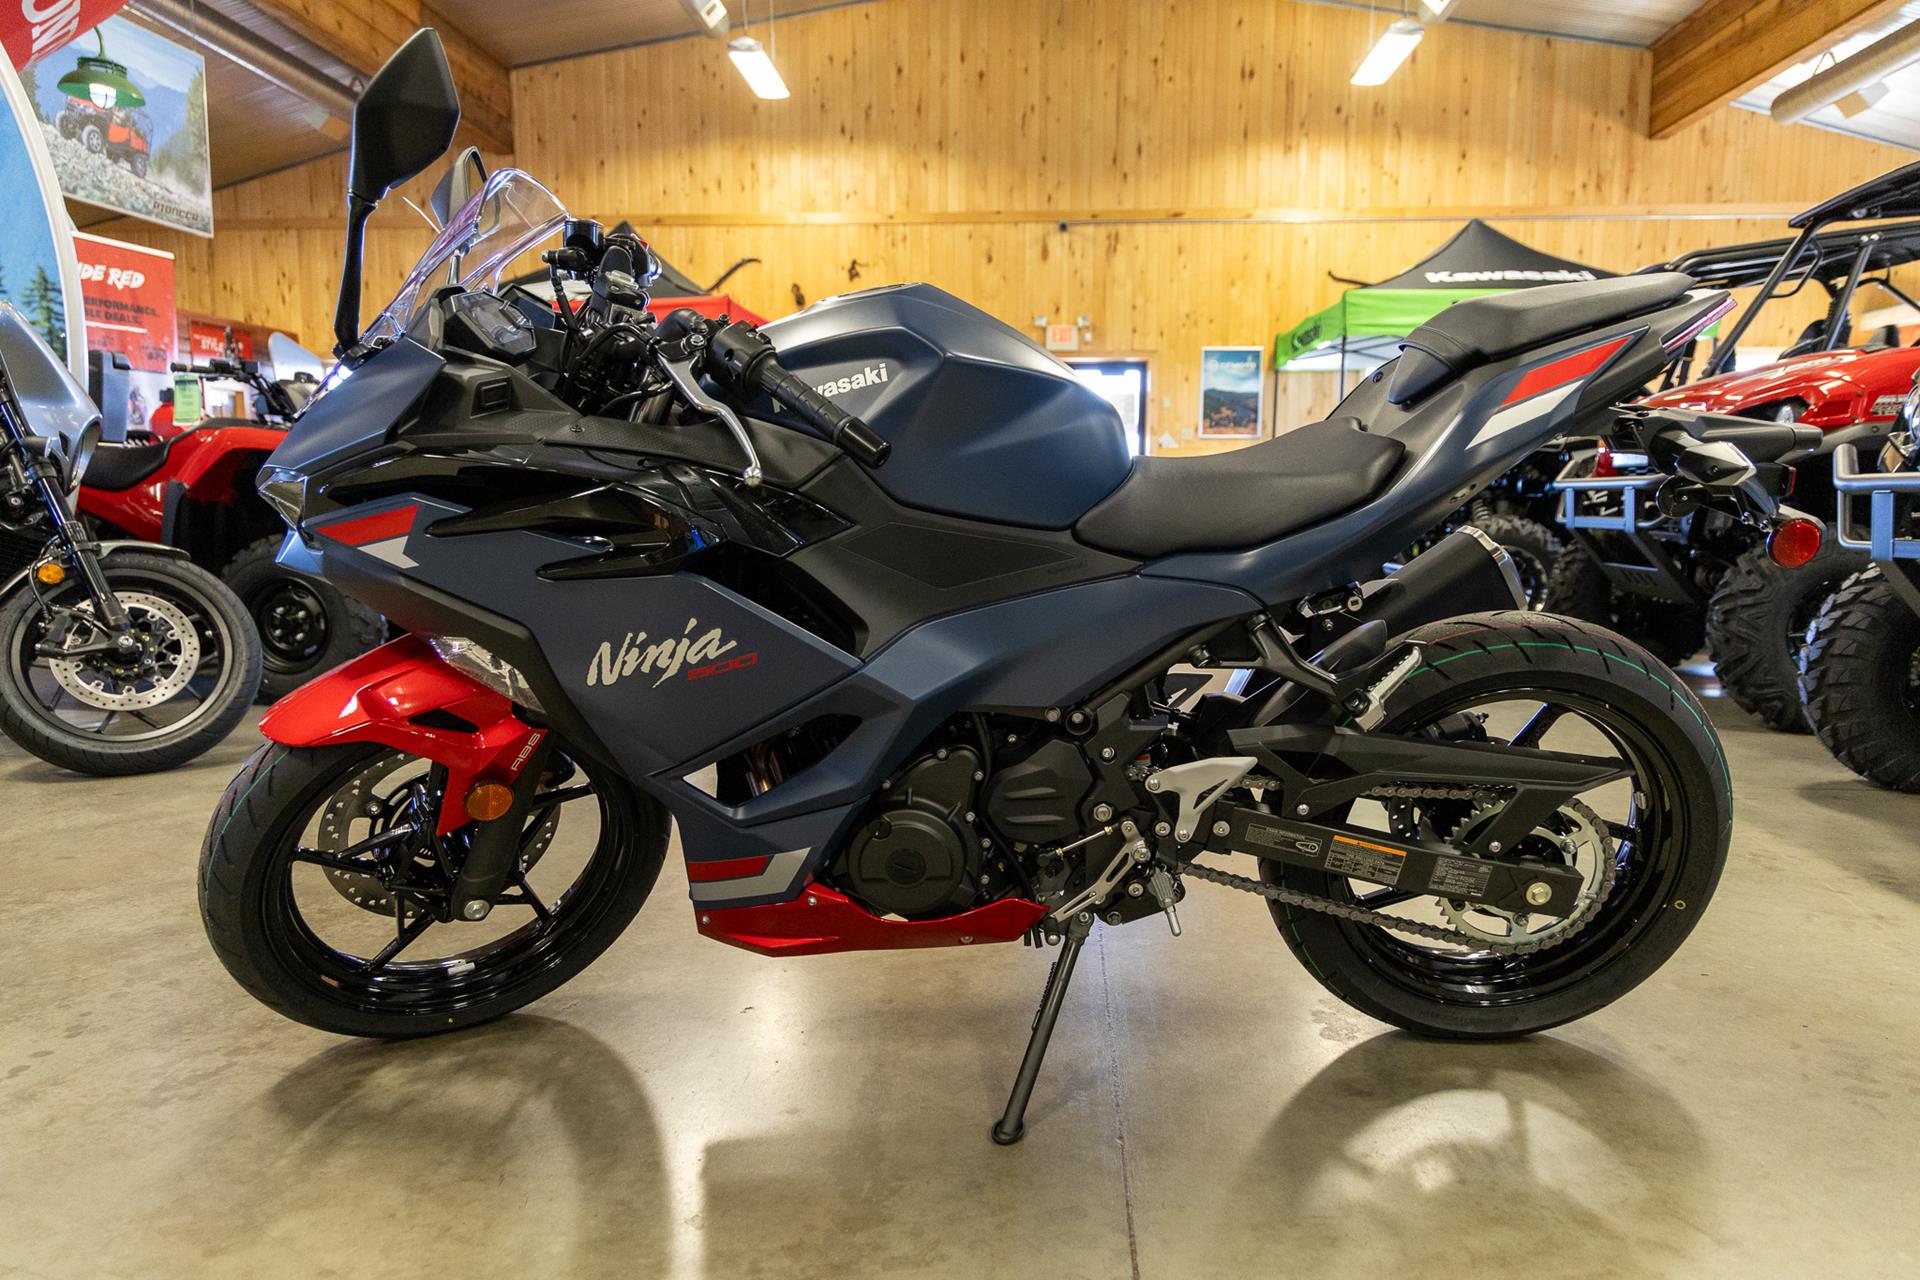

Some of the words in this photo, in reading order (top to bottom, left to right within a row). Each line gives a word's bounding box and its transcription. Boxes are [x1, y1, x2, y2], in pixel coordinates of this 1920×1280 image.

[106, 267, 145, 291] RED
[1424, 269, 1597, 283] Kawasaki
[586, 617, 738, 689] Ninja
[687, 652, 759, 681] 500
[511, 732, 541, 771] ABS
